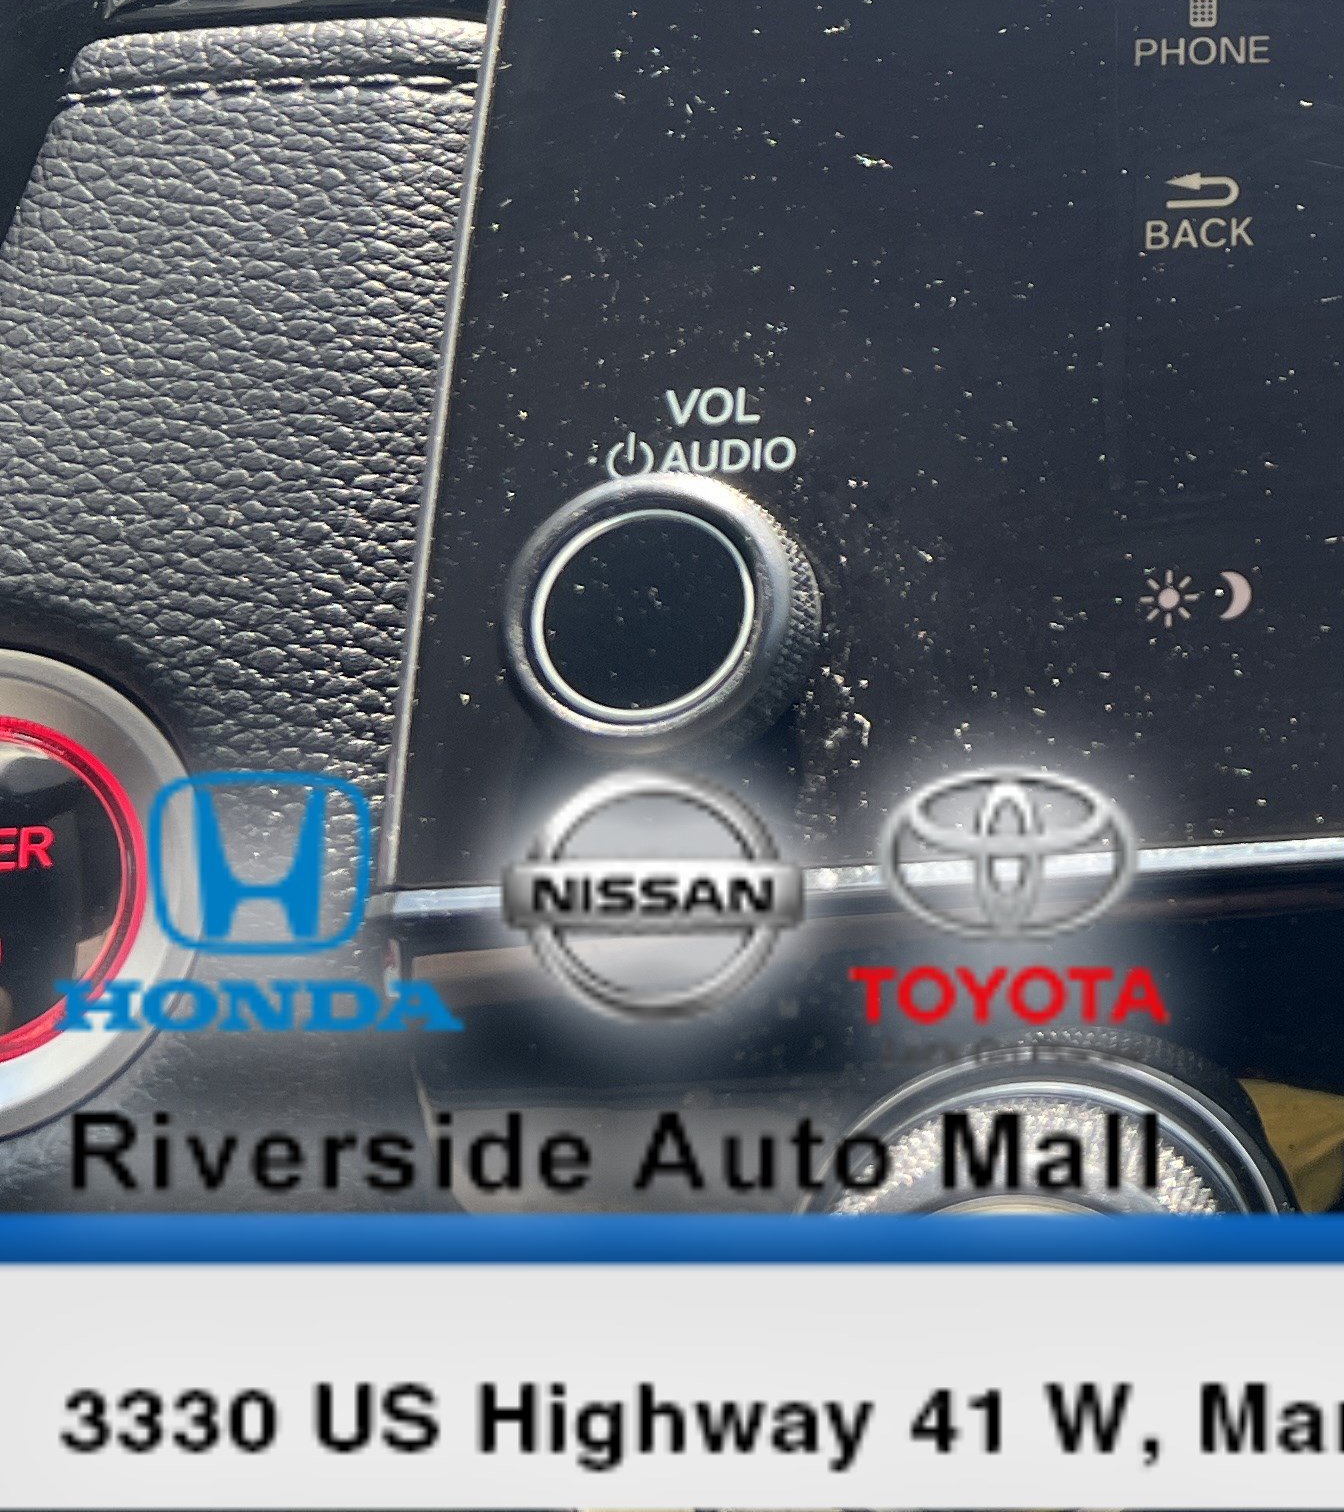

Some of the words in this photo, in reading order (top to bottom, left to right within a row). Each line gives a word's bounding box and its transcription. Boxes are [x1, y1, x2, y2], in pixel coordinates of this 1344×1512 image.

[1134, 35, 1270, 66] PHONE
[1145, 216, 1254, 250] BACK
[665, 386, 761, 425] VOL
[662, 435, 797, 474] AUDIO
